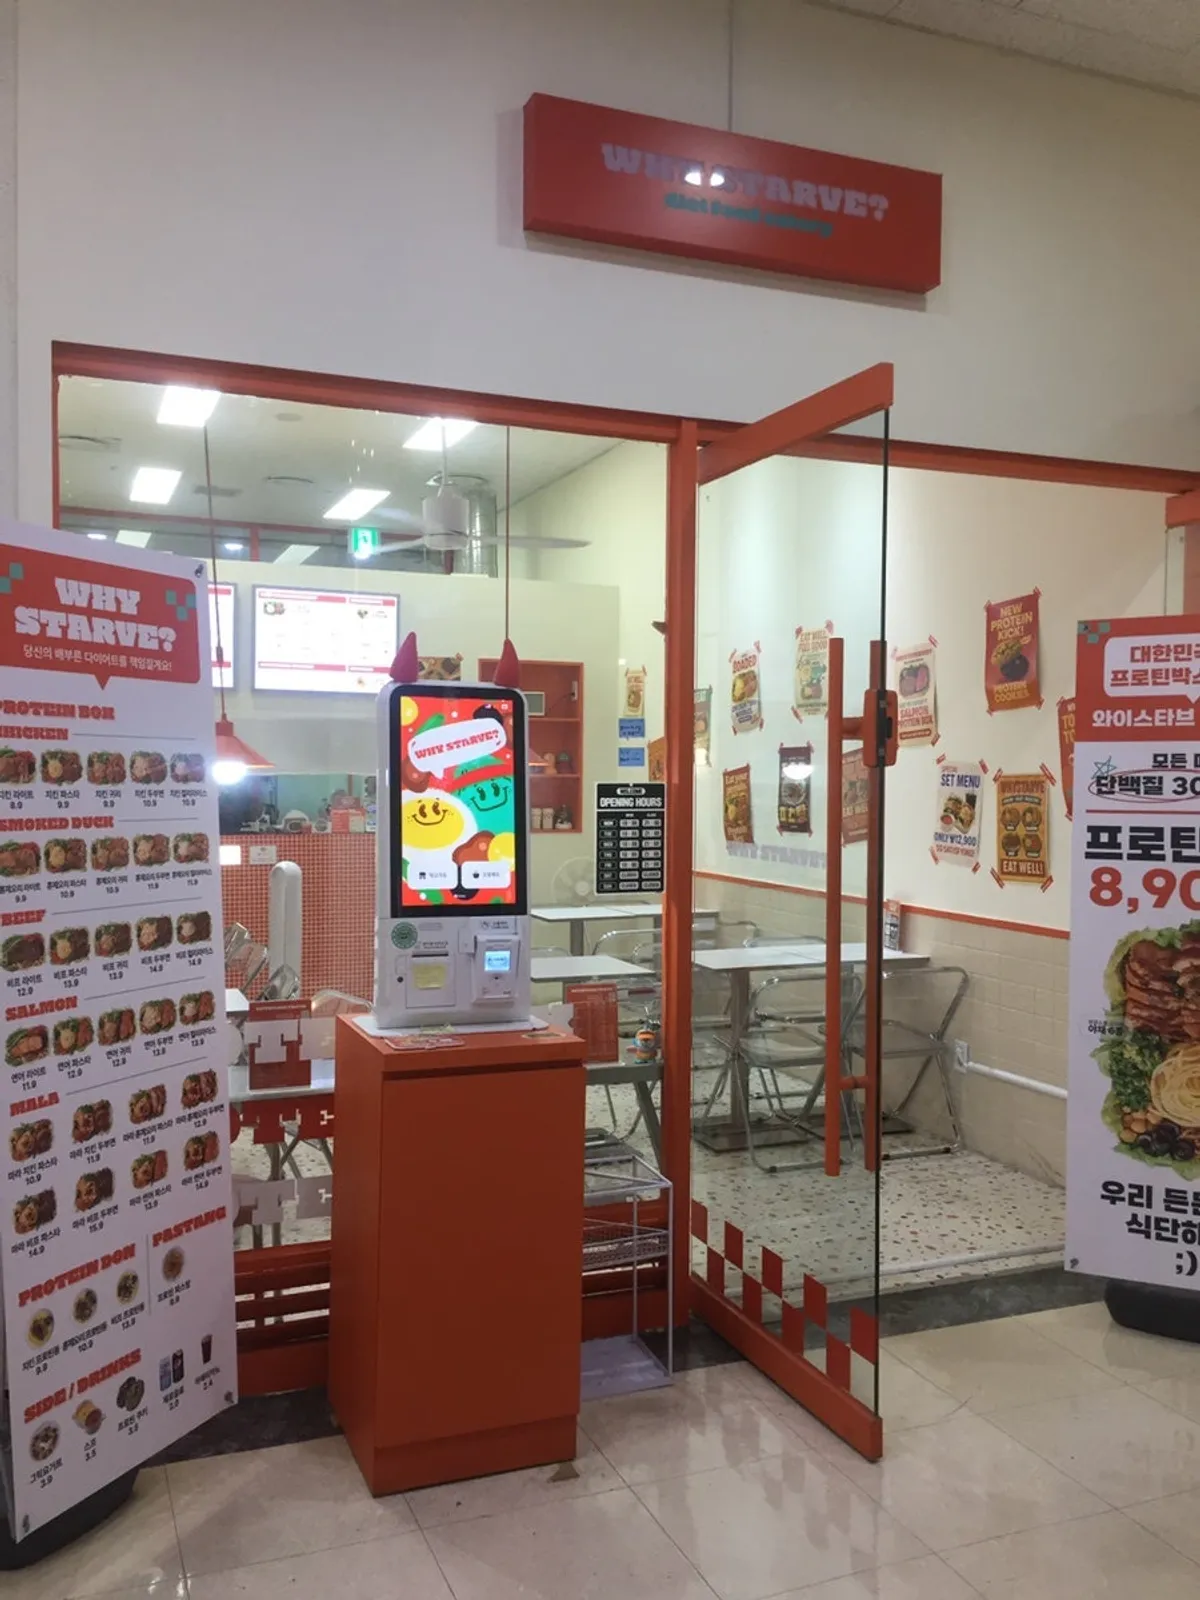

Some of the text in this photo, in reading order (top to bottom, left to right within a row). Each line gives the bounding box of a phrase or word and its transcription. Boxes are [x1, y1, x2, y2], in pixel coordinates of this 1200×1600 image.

[711, 164, 889, 222] STARVE?
[55, 577, 140, 615] WHY
[14, 606, 176, 652] STARVE?
[1130, 643, 1200, 663] 대한민
[0, 699, 76, 718] ROTEIN
[1092, 708, 1195, 727] 와이스타브
[0, 725, 69, 741] HICKEN
[415, 729, 500, 760] WHY STARVE?
[1152, 752, 1187, 769] 모든
[940, 773, 981, 789] SET MENU
[1096, 775, 1163, 796] 단백질
[599, 797, 662, 807] OPENING HOURS
[71, 816, 114, 829] DUCK
[1002, 861, 1018, 874] EAT
[5, 995, 78, 1022] SALMON
[1101, 1180, 1153, 1209] 우리
[152, 1206, 227, 1248] PASTANG
[18, 1243, 137, 1308] PROTEIN DON
